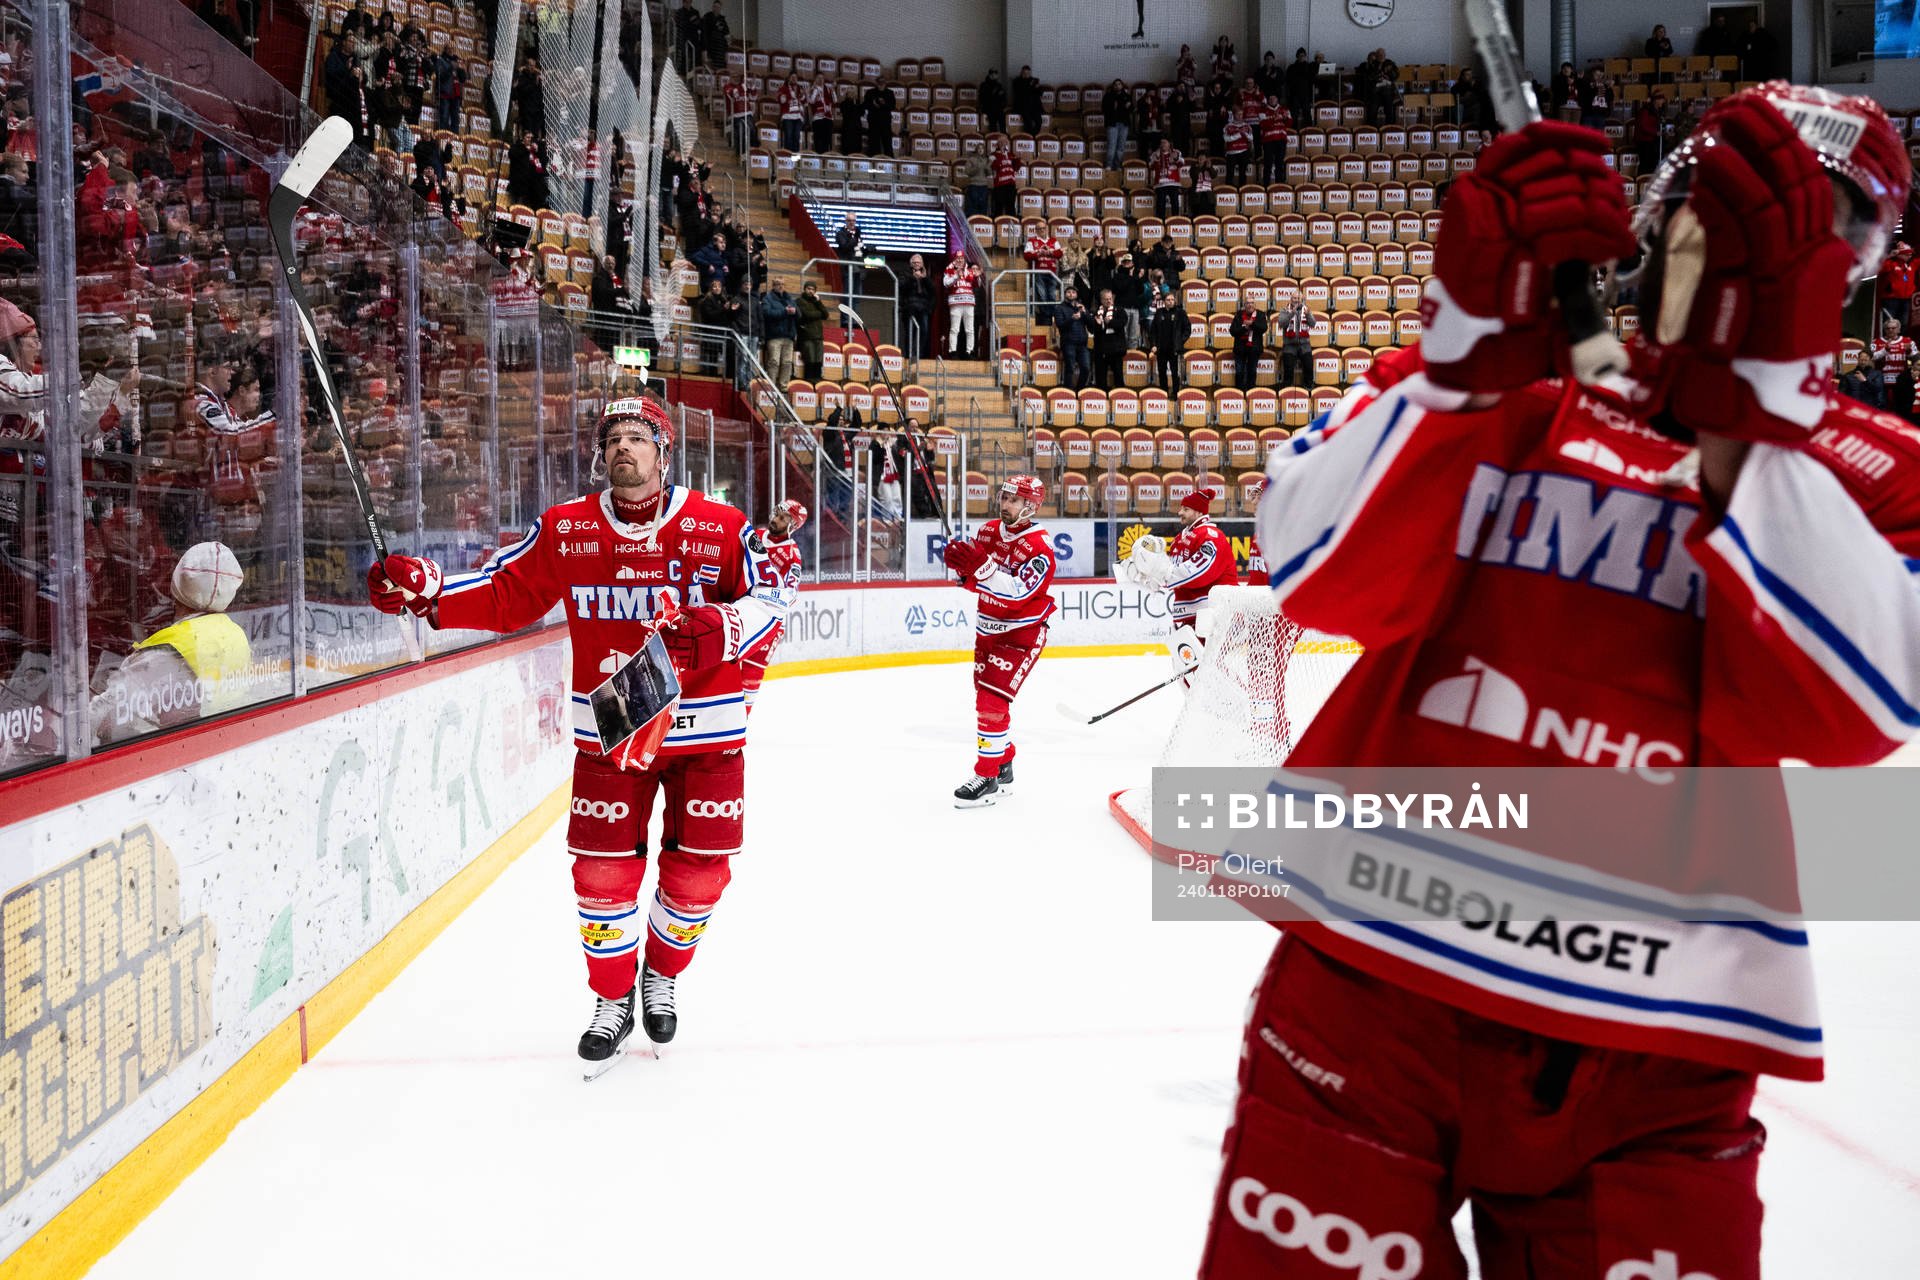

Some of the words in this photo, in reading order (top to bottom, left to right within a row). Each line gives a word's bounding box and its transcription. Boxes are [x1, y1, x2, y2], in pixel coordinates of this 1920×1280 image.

[574, 520, 600, 531] SCA
[698, 521, 724, 534] SCA
[570, 541, 599, 555] LILIUM
[692, 542, 721, 558] LILIUM
[1190, 552, 1208, 569] 31
[636, 570, 664, 579] NHC
[668, 560, 682, 581] C
[931, 609, 969, 628] SCA
[1530, 706, 1686, 785] NHC
[1346, 852, 1671, 977] BILBOLAGET
[2, 831, 155, 1037] EURO
